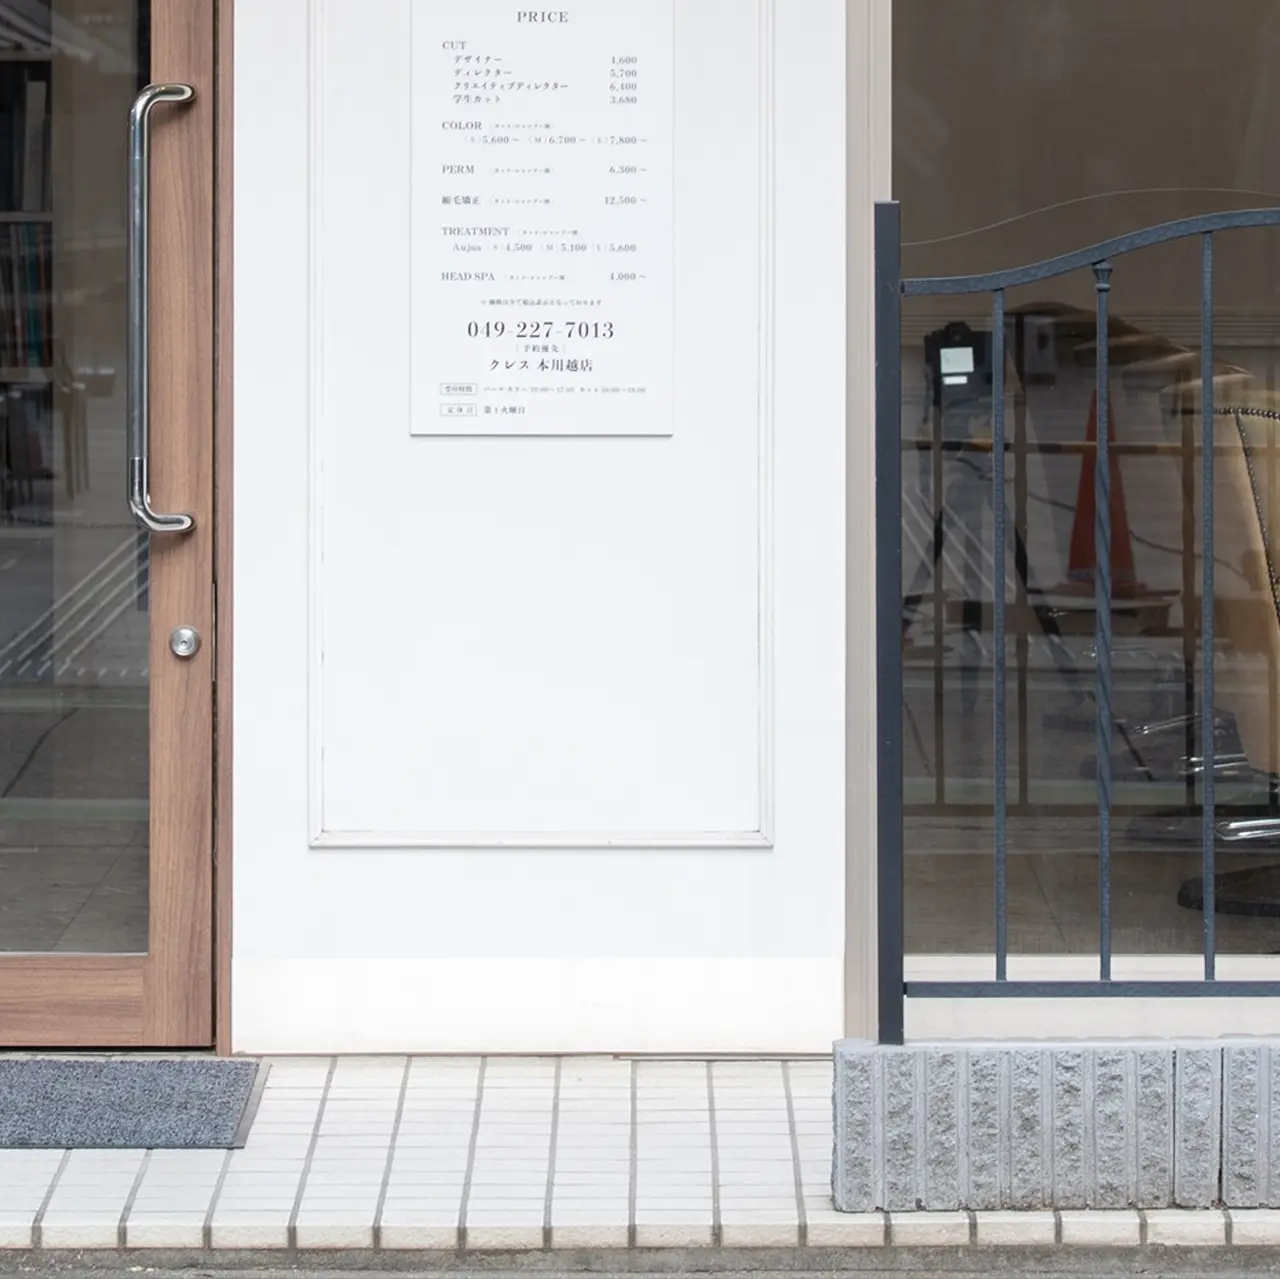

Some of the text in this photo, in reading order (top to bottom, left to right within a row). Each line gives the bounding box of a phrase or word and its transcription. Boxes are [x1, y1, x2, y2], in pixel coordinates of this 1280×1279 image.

[516, 11, 569, 23] PRICE
[442, 41, 467, 50] CUT
[610, 69, 637, 78] 5,700
[610, 96, 637, 104] 3,680
[442, 121, 482, 130] COLOR
[442, 165, 474, 174] PERM
[442, 196, 481, 205] 縮毛矯正
[442, 227, 509, 236] TREATMENT
[442, 272, 471, 281] HEAD
[474, 272, 495, 281] SPA
[468, 321, 614, 338] 049-227-7013
[489, 359, 593, 372] クレス 本川越店
